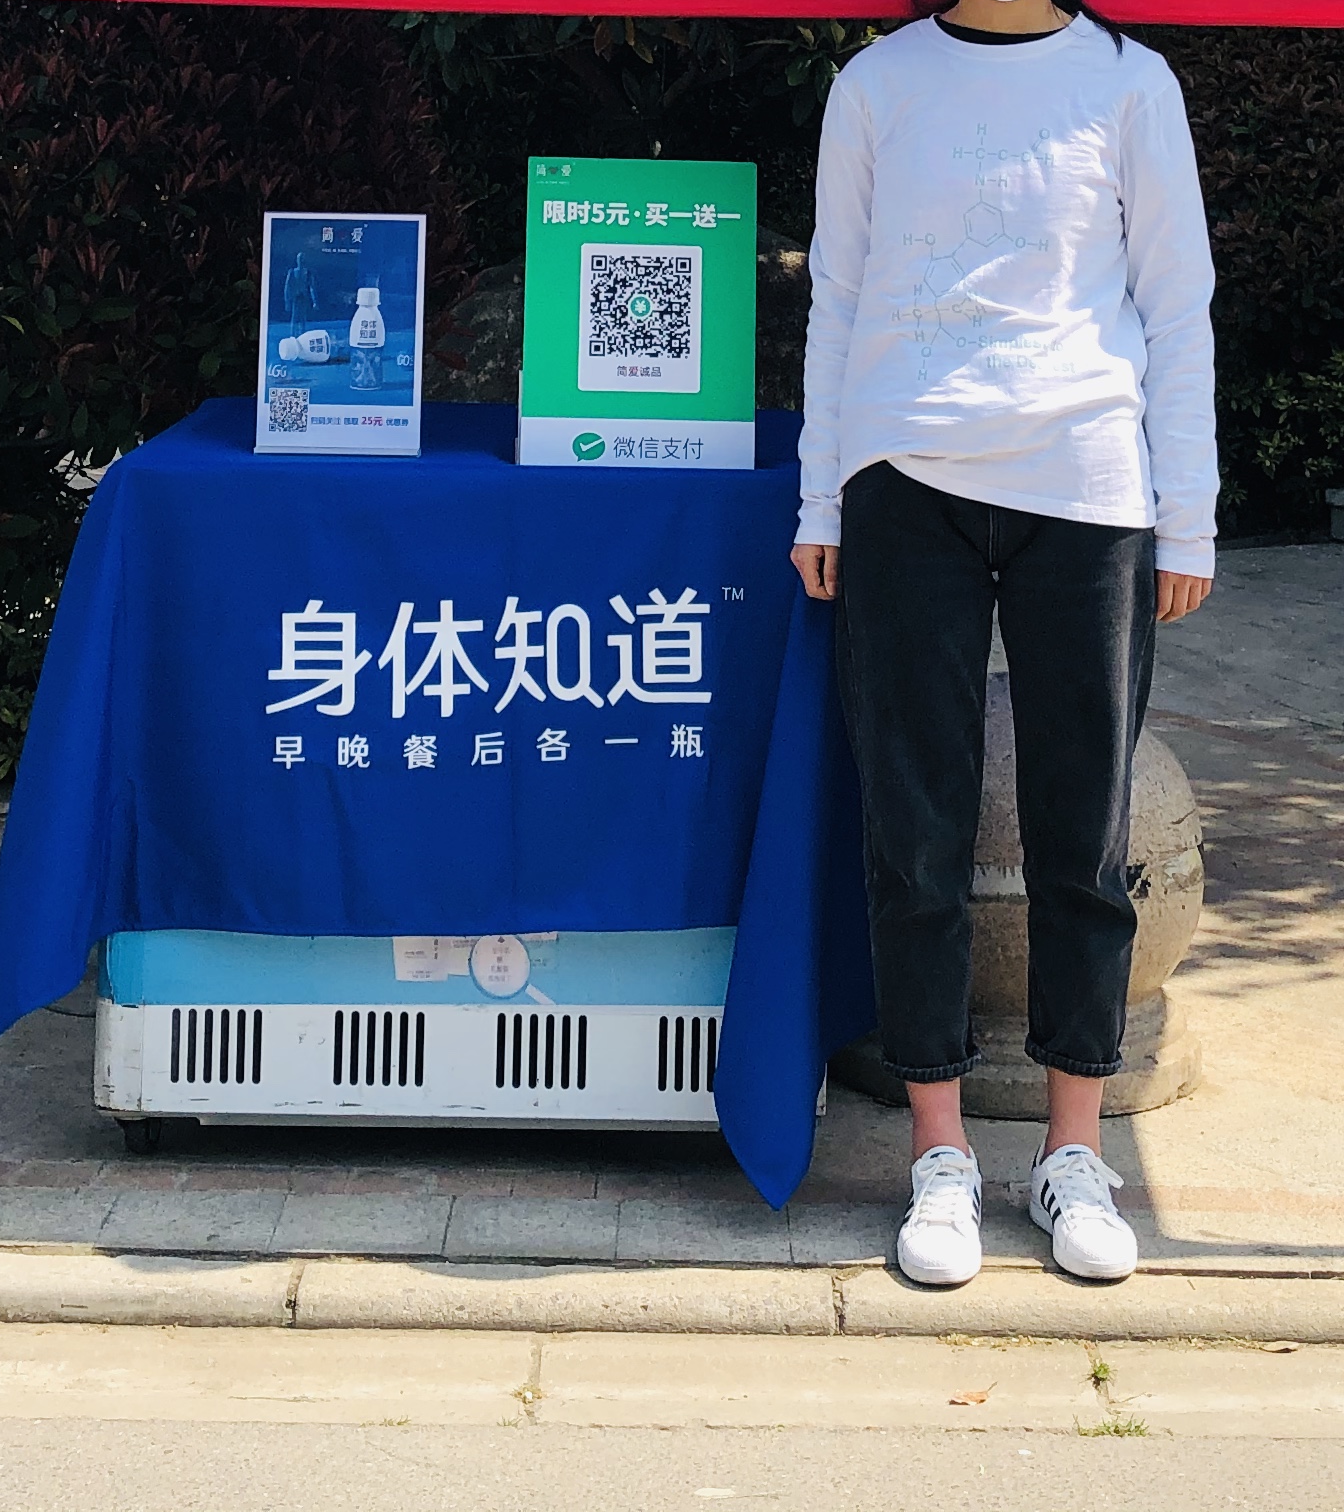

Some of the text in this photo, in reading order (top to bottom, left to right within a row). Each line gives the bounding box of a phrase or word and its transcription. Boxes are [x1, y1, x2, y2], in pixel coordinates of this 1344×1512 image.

[542, 199, 742, 229] 限时5元·买一送一
[360, 416, 384, 427] 25元
[612, 435, 705, 461] 微信支付
[265, 587, 712, 719] 身体知道
[271, 724, 704, 770] 早晚餐后各一瓶
